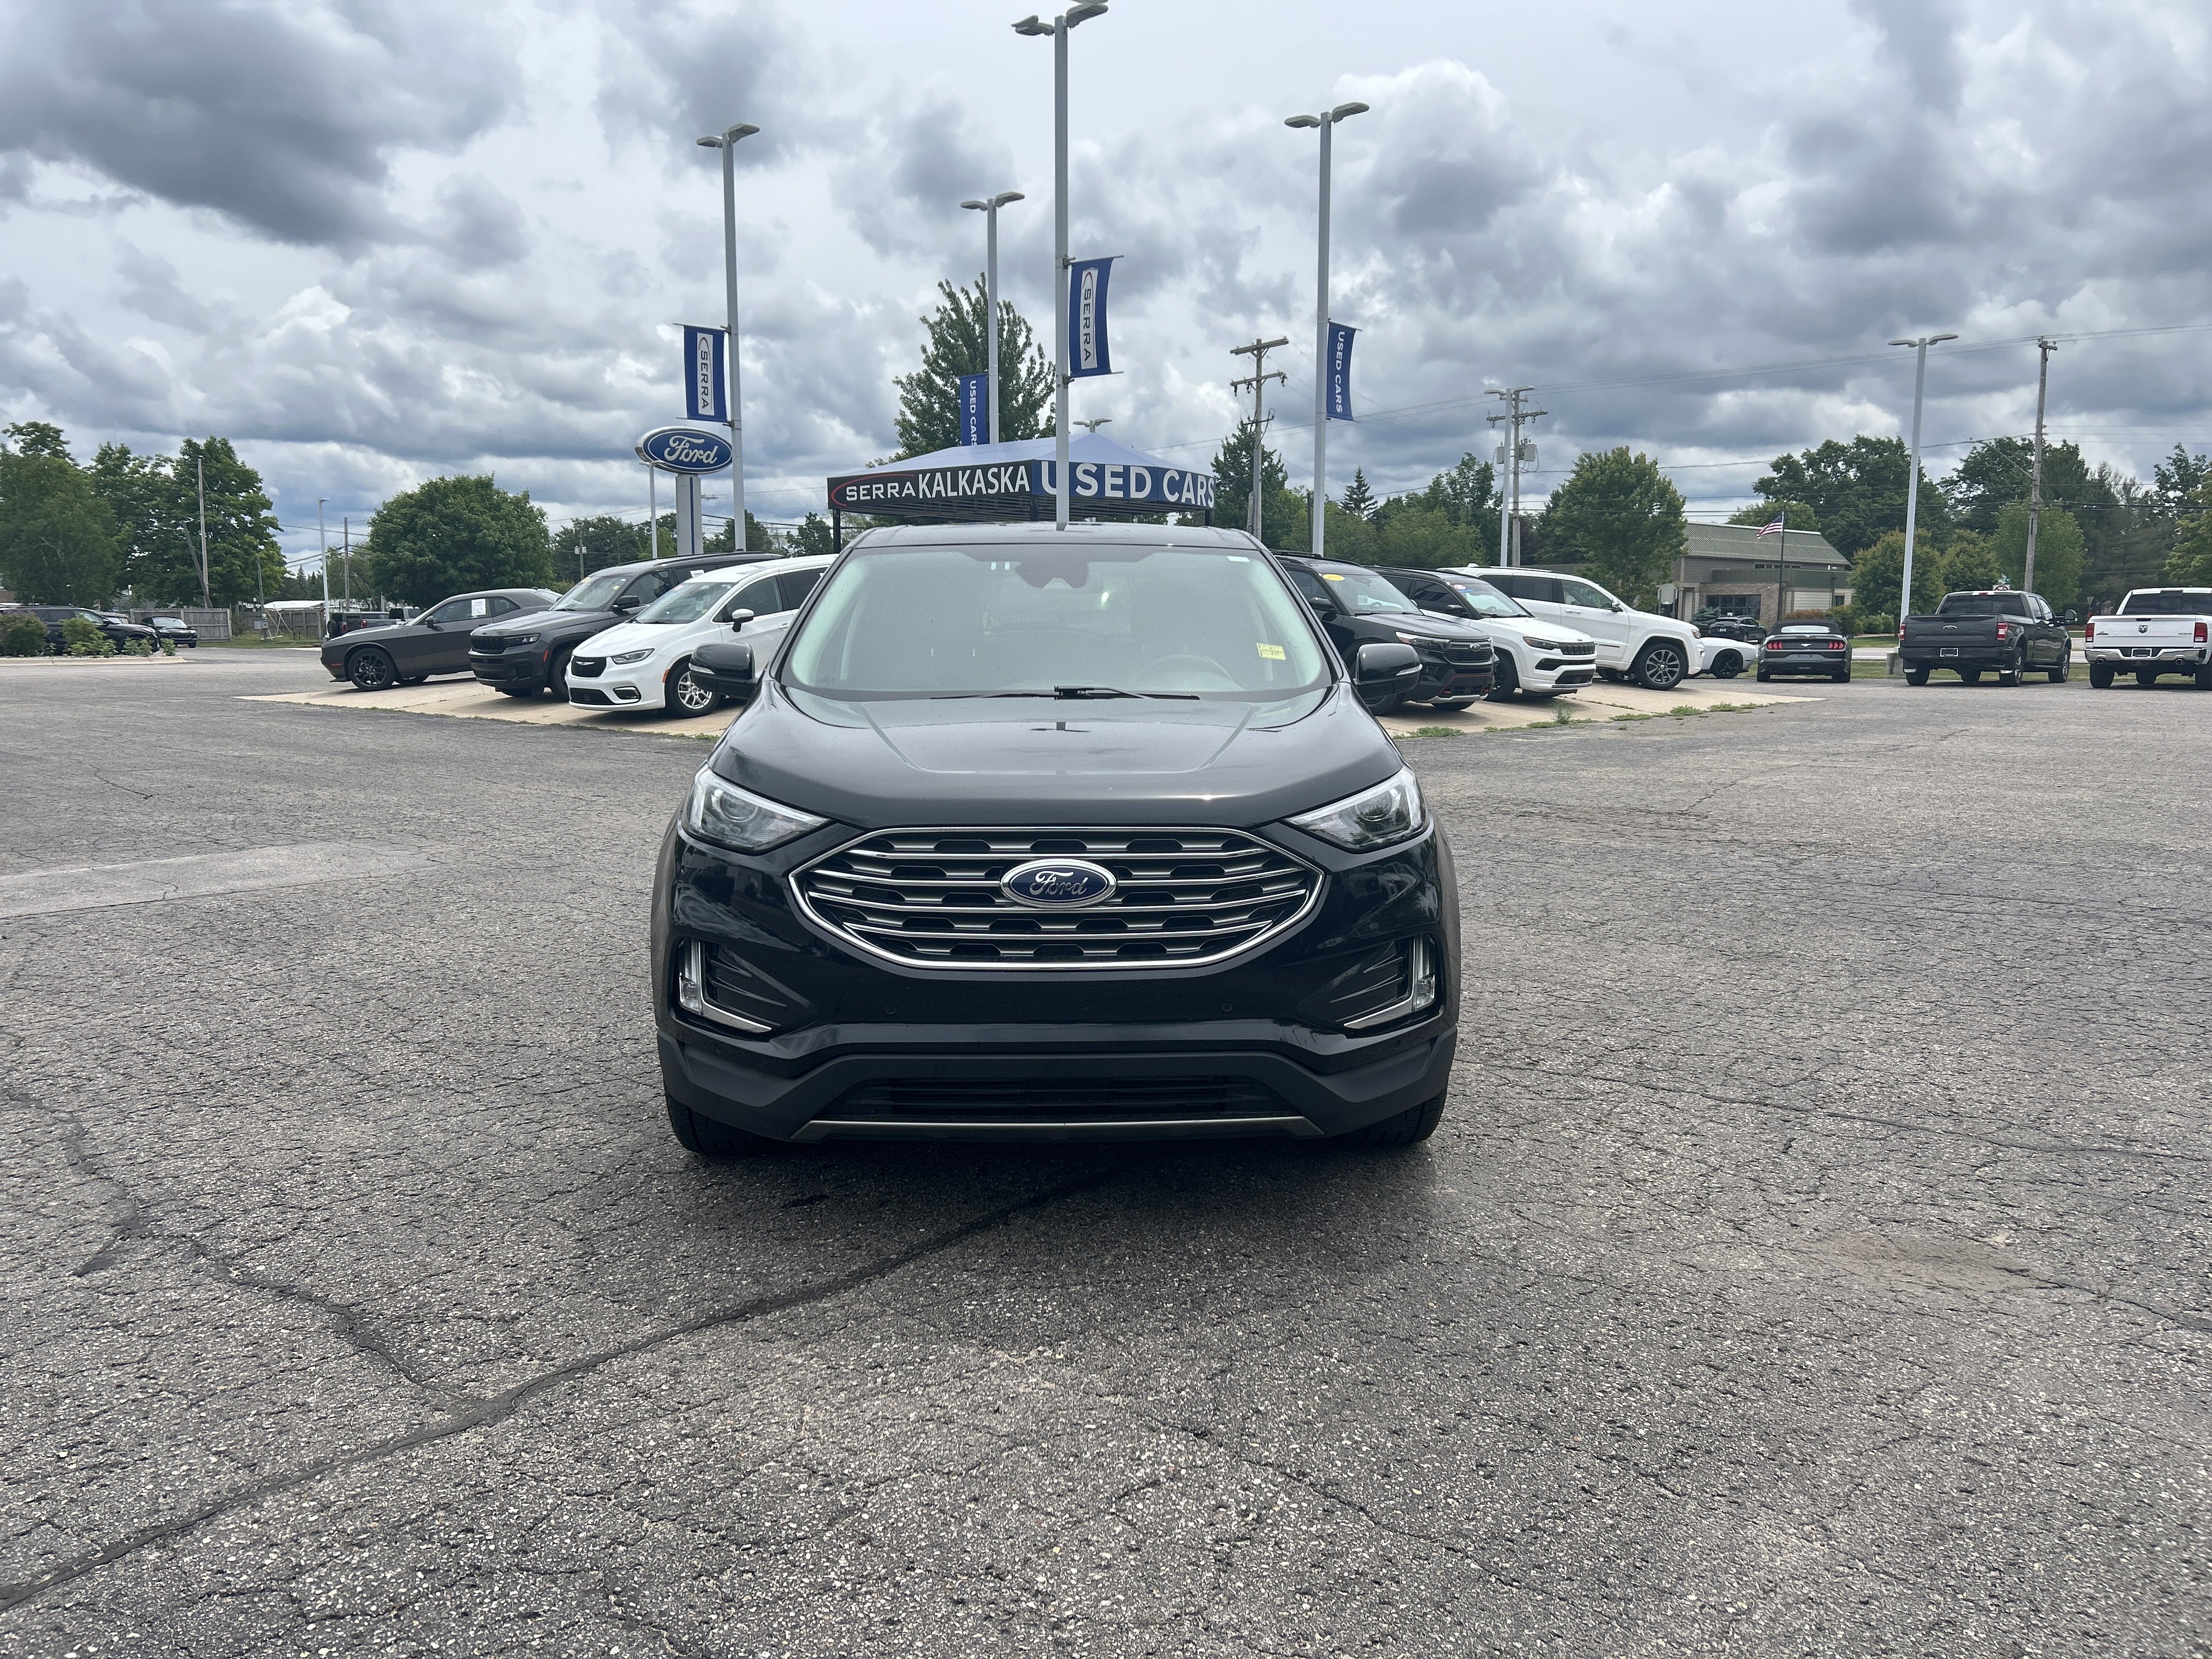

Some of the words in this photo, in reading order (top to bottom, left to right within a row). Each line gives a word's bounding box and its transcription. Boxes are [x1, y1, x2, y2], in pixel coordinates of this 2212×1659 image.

[1082, 288, 1092, 362] SERRA
[1335, 331, 1346, 371] USED
[699, 350, 709, 409] SERRA
[1335, 374, 1343, 413] CARS
[663, 435, 719, 464] Ford
[845, 481, 916, 501] SERRA
[918, 465, 1030, 499] KALKASKA
[1163, 469, 1215, 509] CARS
[1029, 871, 1088, 895] Ford
